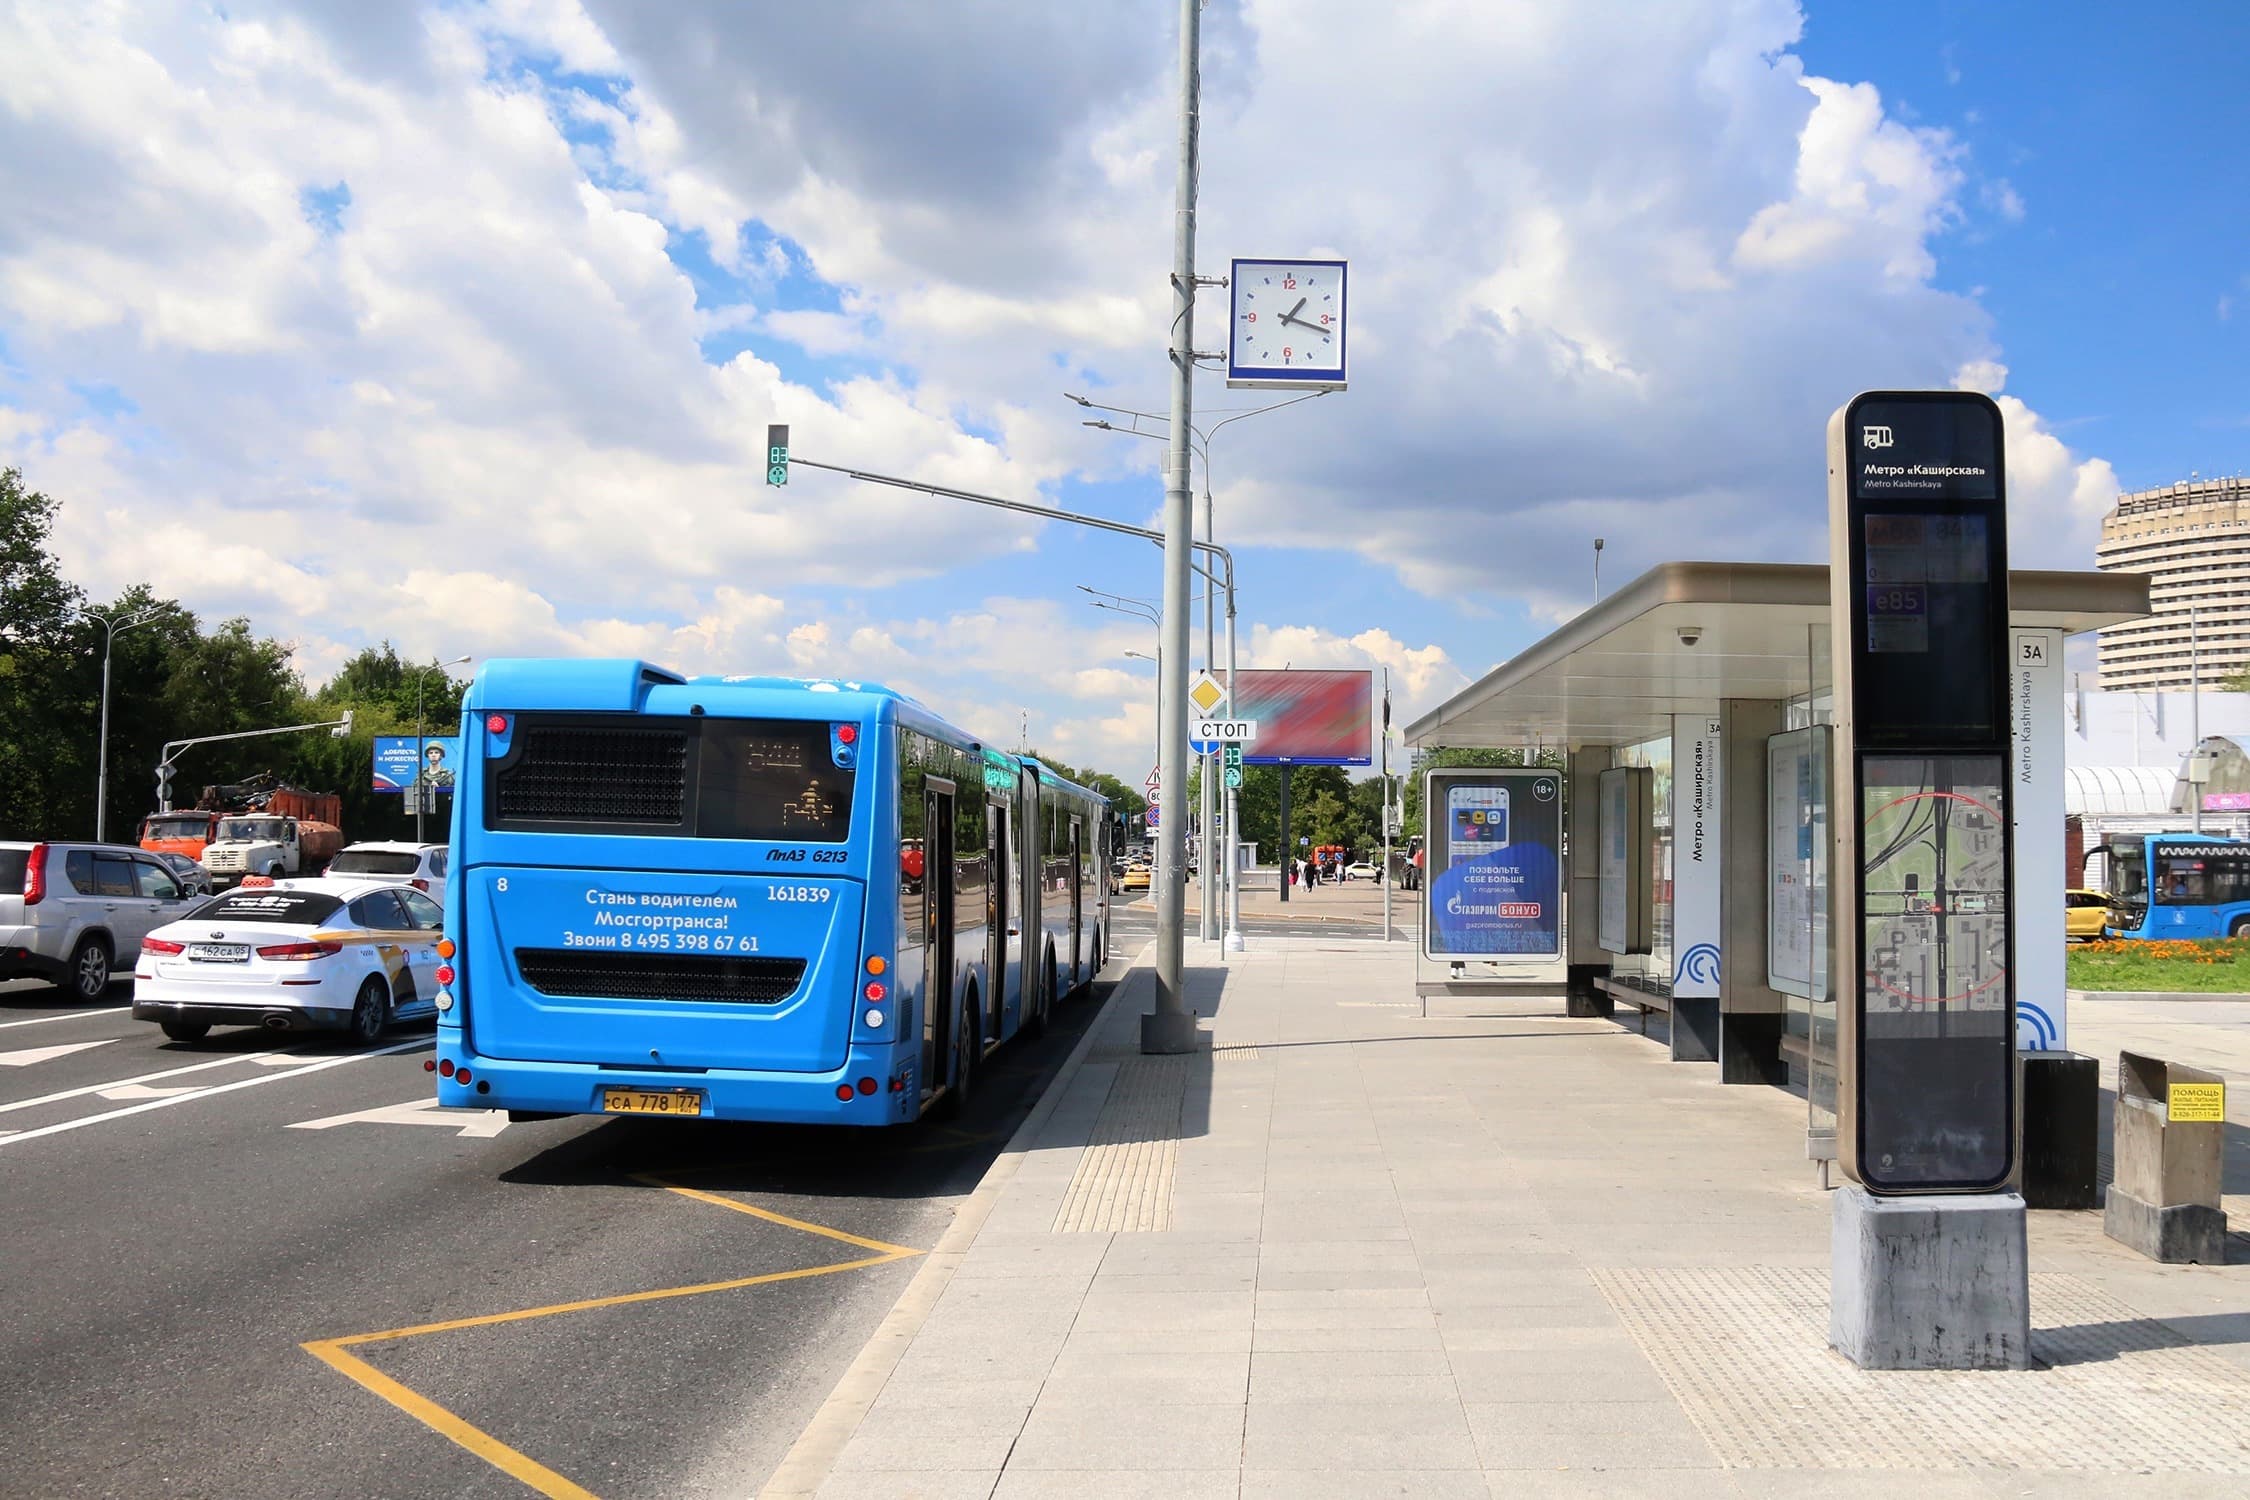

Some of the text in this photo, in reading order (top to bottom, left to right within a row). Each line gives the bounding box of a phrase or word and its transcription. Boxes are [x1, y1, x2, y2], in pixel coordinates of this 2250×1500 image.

[1282, 279, 1297, 290] 12
[1248, 312, 1257, 323] 9
[1320, 314, 1329, 325] 3
[1283, 347, 1292, 358] 6
[771, 446, 788, 464] 83
[1864, 464, 1985, 477] Метро «Каширская»
[1864, 480, 1942, 489] Metro Kashirskaya
[1201, 723, 1247, 737] СТОП
[2020, 671, 2033, 784] Metro Kashirskaya
[1535, 785, 1553, 794] 18+
[1692, 741, 1705, 862] Метро «Каширская»
[812, 850, 848, 863] 6213
[1469, 866, 1520, 874] ПОЗВОЛЬТЕ
[497, 877, 508, 892] 8
[1464, 875, 1525, 884] СЕБЕ БОЛЬШЕ
[585, 888, 738, 909] Стань водителем
[767, 885, 831, 903] 161839
[1501, 905, 1538, 915] БОНУС
[594, 911, 729, 931] Мосгортранса!
[563, 931, 759, 952] Звони 8 495 398 67 61
[639, 1094, 669, 1111] 778
[678, 1095, 695, 1108] 77
